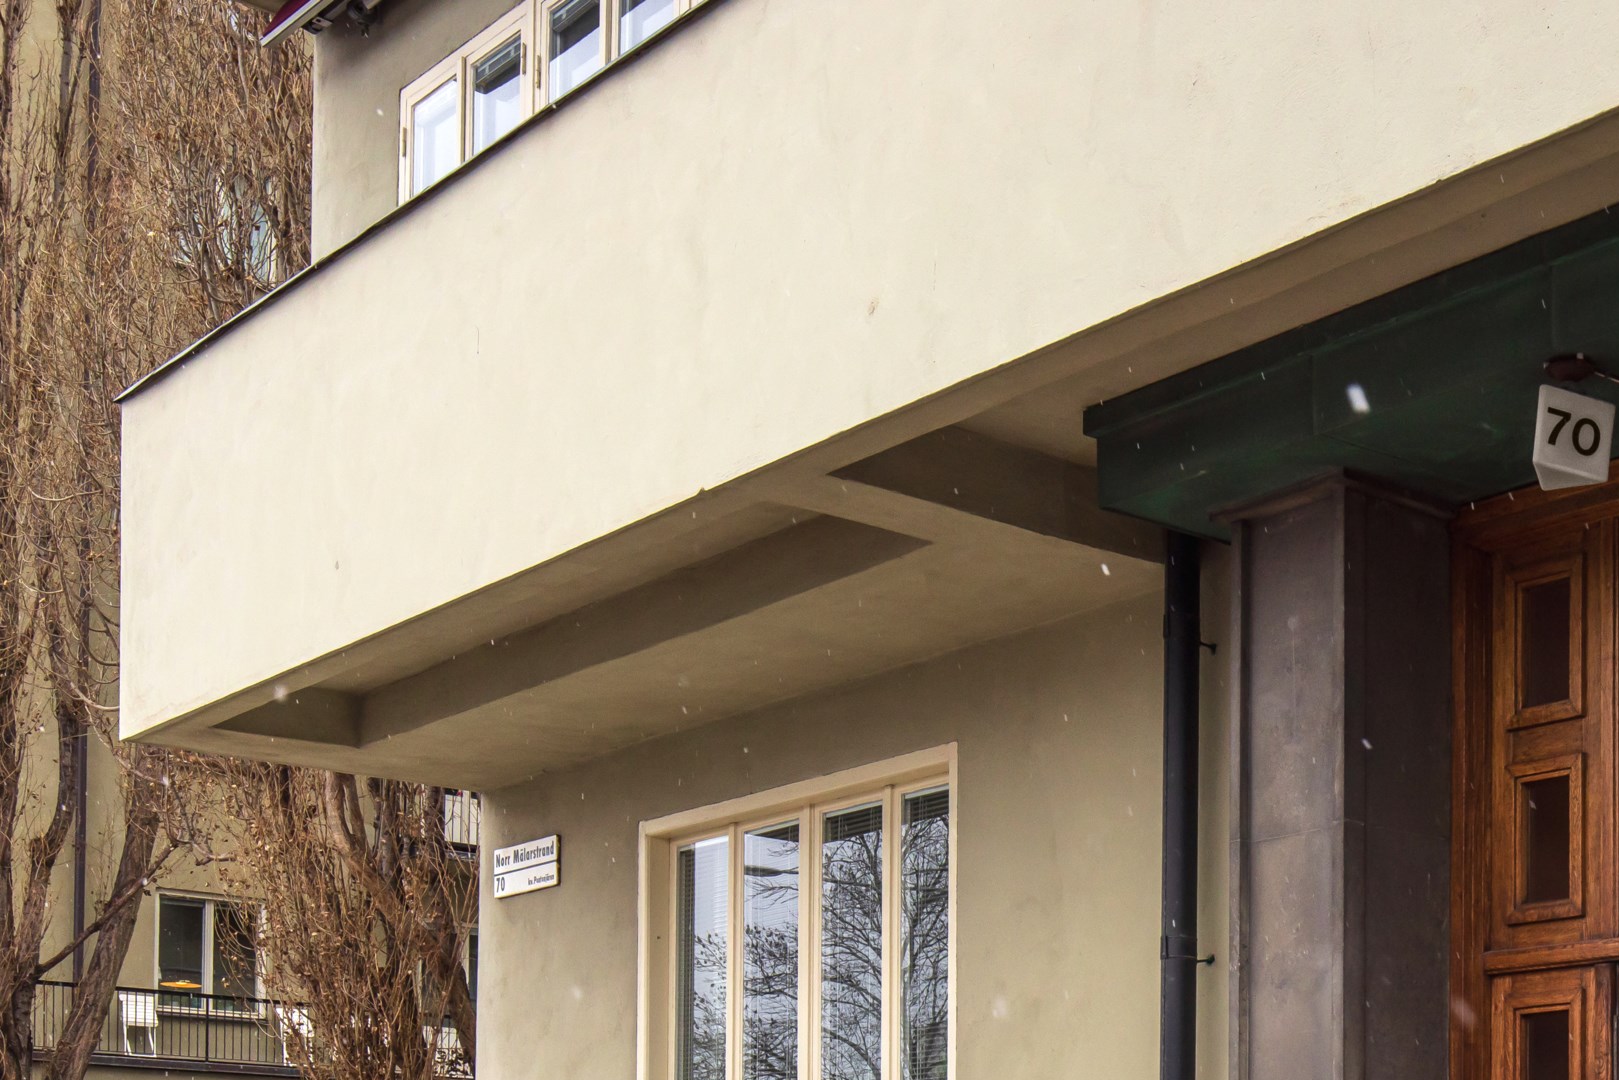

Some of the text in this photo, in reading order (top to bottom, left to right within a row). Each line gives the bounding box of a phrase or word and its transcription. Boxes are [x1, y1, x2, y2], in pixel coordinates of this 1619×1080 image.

[1547, 406, 1601, 456] 70
[496, 841, 554, 868] Norr Mälarstrand
[496, 877, 505, 893] 70
